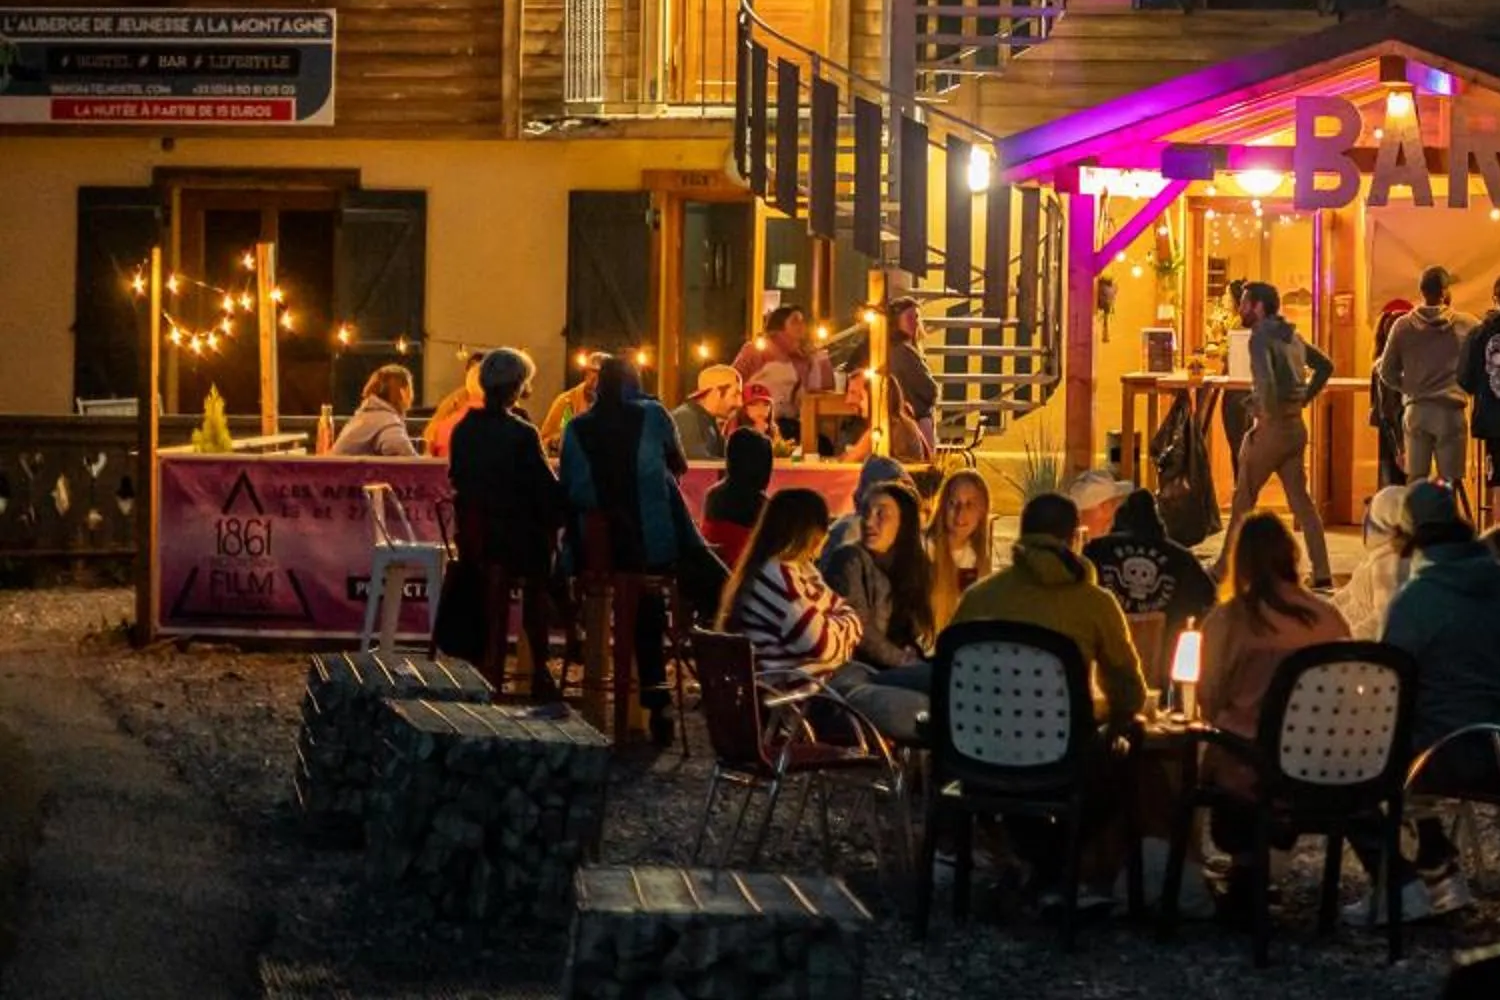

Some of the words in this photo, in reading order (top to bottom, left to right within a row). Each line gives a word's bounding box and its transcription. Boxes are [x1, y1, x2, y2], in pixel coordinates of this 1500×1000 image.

[3, 16, 90, 32] L'AUBERGE
[93, 16, 113, 33] DE
[116, 16, 189, 33] JEUNESSE
[207, 17, 228, 32] LA
[231, 17, 328, 33] MONTAGNE
[158, 55, 187, 69] BAR
[209, 55, 291, 69] LIFESTYLE
[73, 105, 90, 117] LA
[199, 105, 213, 118] DE
[214, 518, 272, 556] 1861
[209, 570, 274, 596] FILM
